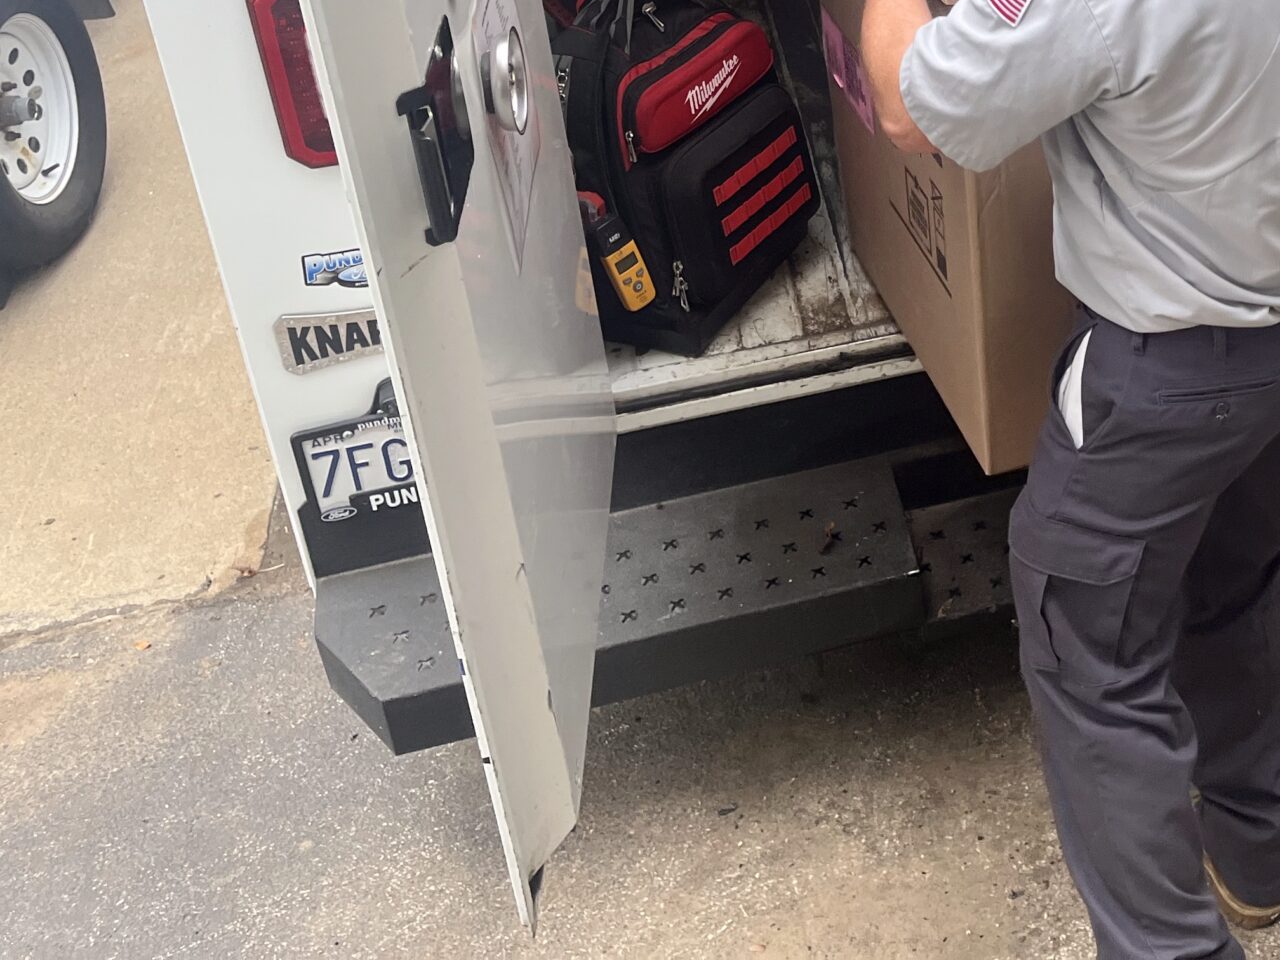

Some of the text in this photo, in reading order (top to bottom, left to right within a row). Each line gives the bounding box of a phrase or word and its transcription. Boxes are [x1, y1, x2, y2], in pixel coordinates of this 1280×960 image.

[684, 54, 740, 115] Milwaukee
[311, 438, 414, 498] 7FG
[369, 486, 419, 511] PUN
